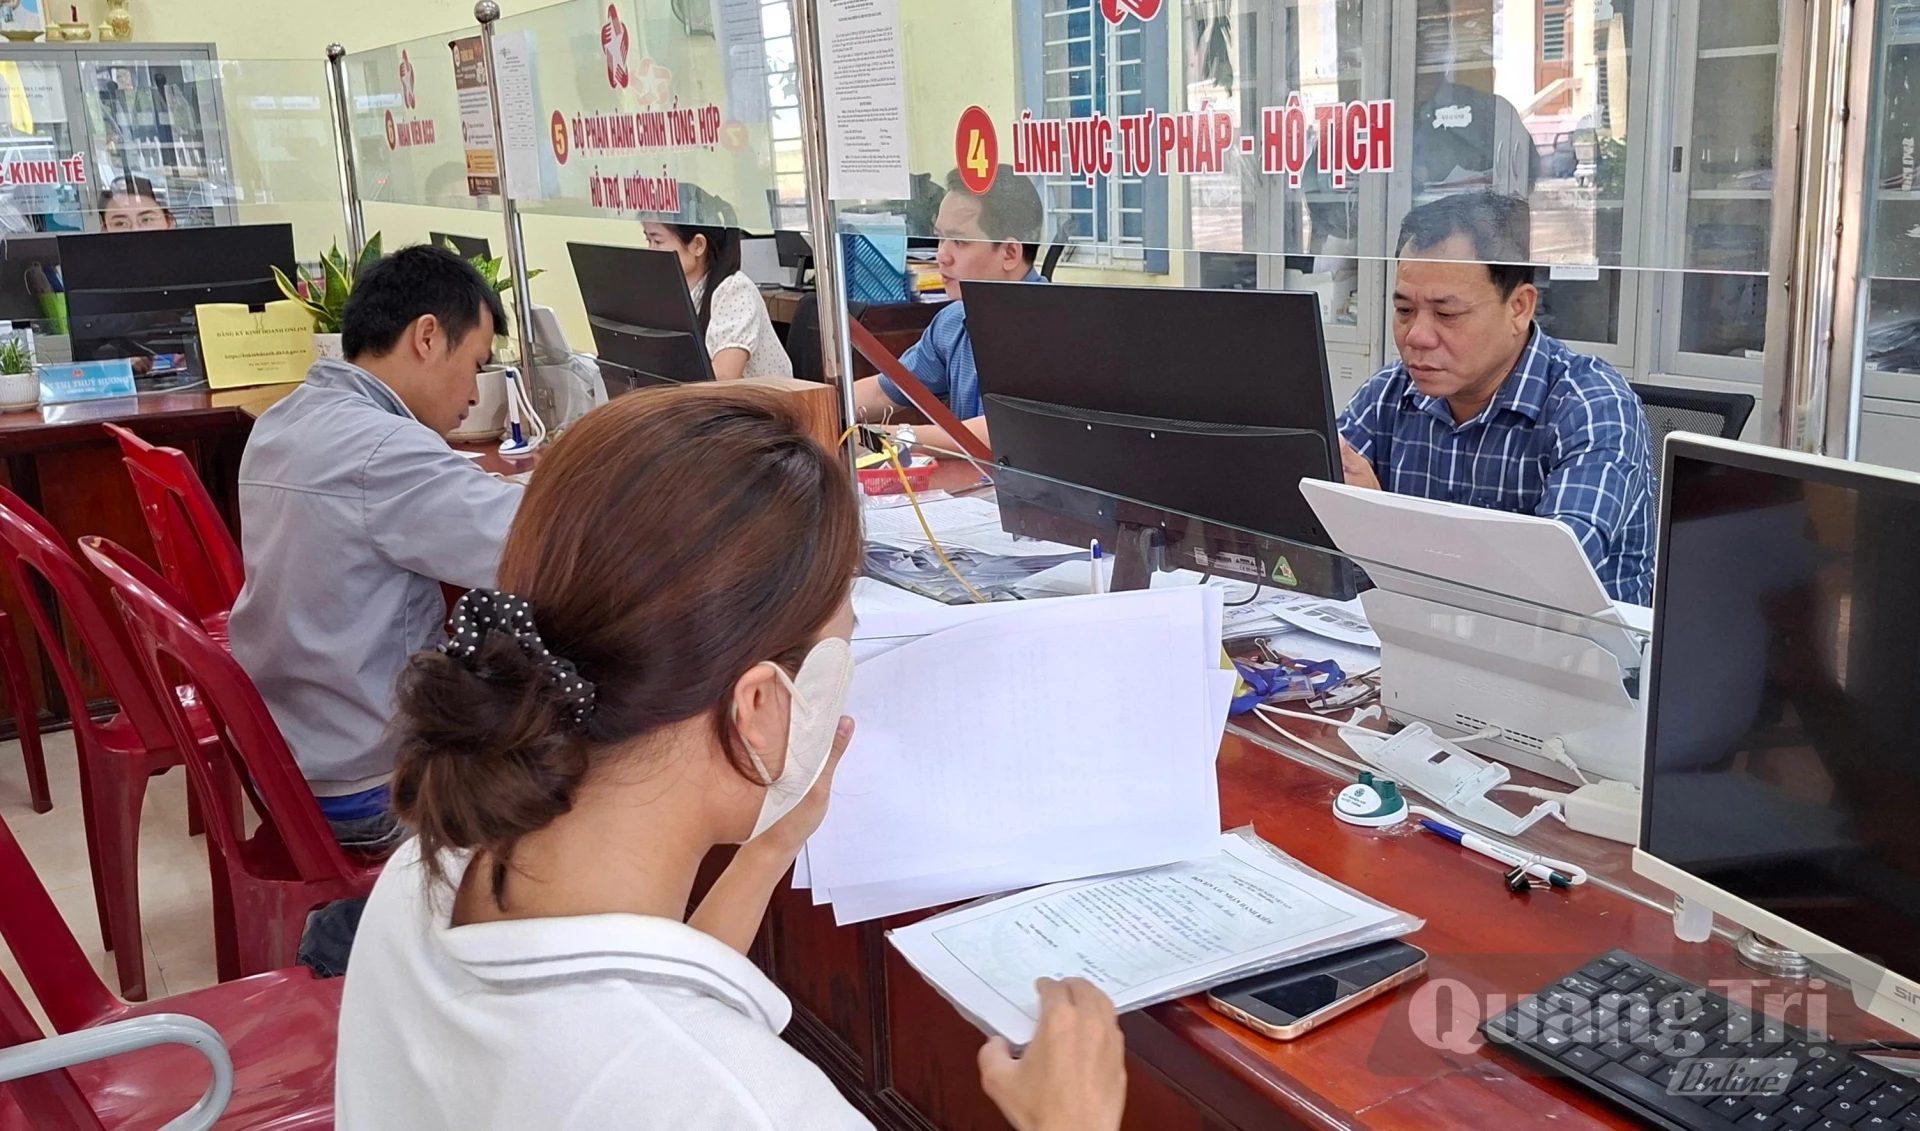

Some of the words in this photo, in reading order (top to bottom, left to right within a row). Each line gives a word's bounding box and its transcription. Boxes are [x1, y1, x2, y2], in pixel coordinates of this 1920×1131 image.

[554, 123, 565, 155] 5
[585, 110, 609, 156] PHẬN
[609, 108, 635, 148] HÀNH
[636, 105, 667, 147] CHÍNH
[667, 95, 696, 146] TỔNG
[697, 103, 721, 152] HỢP
[1012, 111, 1062, 174] LĨNH
[1067, 114, 1113, 186] VỰC
[1119, 110, 1153, 174] TƯ
[1159, 101, 1232, 174] PHÁP
[1264, 95, 1305, 185] HỘ
[1315, 102, 1392, 185] TỊCH
[9, 161, 58, 184] KINH
[61, 152, 86, 183] TẾ
[967, 129, 989, 178] 4
[590, 165, 602, 208] HỖ
[623, 170, 656, 211] HƯỚNG
[656, 164, 679, 212] DẪN
[262, 327, 284, 335] DOANH
